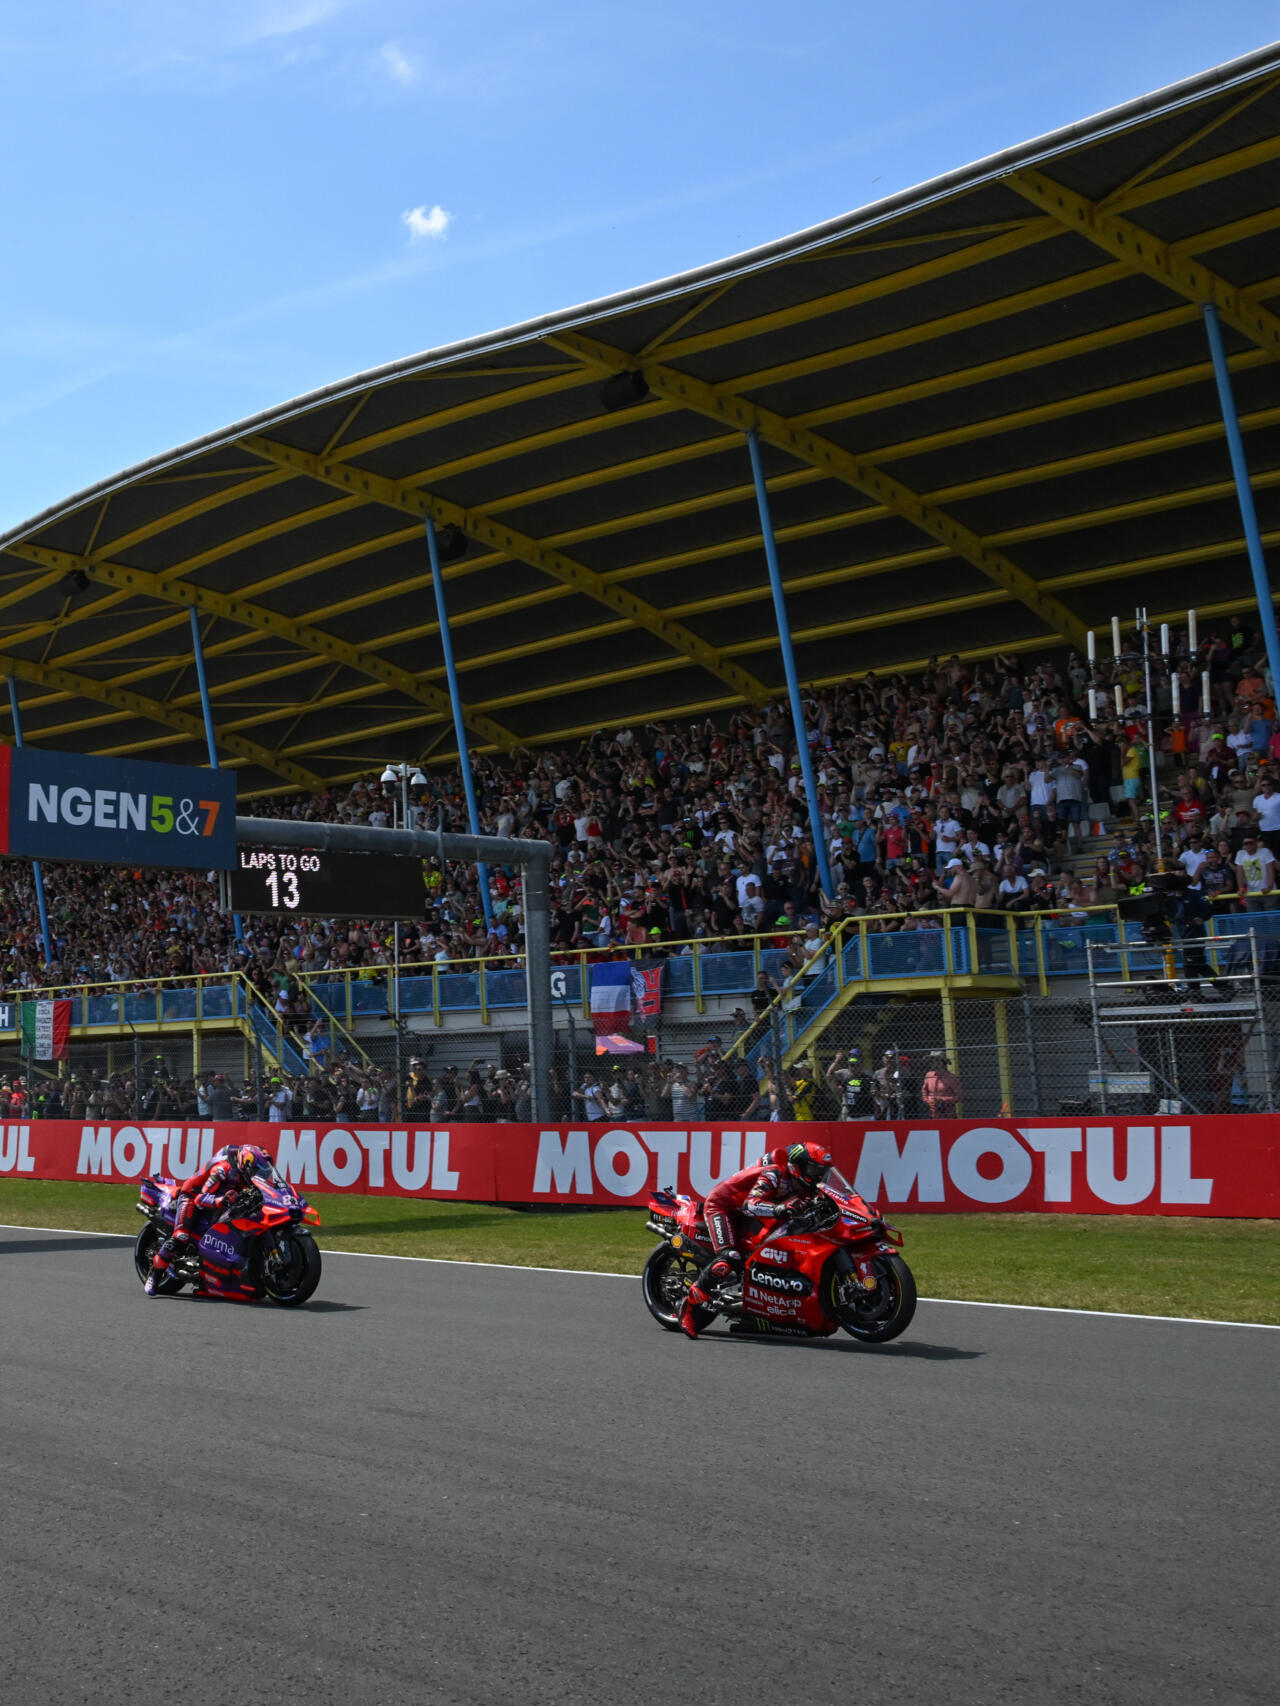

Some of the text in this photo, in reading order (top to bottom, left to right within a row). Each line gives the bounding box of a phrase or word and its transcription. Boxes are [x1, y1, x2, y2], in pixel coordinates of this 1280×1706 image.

[28, 783, 221, 836] NGEN5&7
[241, 852, 320, 872] LAPS TO GO
[265, 871, 300, 909] 13
[551, 971, 567, 998] G
[275, 1129, 460, 1191] MOTUL
[854, 1125, 1215, 1205] MOTUL
[695, 1233, 713, 1242] Leno
[713, 1216, 725, 1245] Lenovo
[203, 1233, 235, 1255] prima
[760, 1247, 788, 1263] GIVI
[751, 1267, 804, 1292] Lenovo
[766, 1305, 797, 1317] elica
